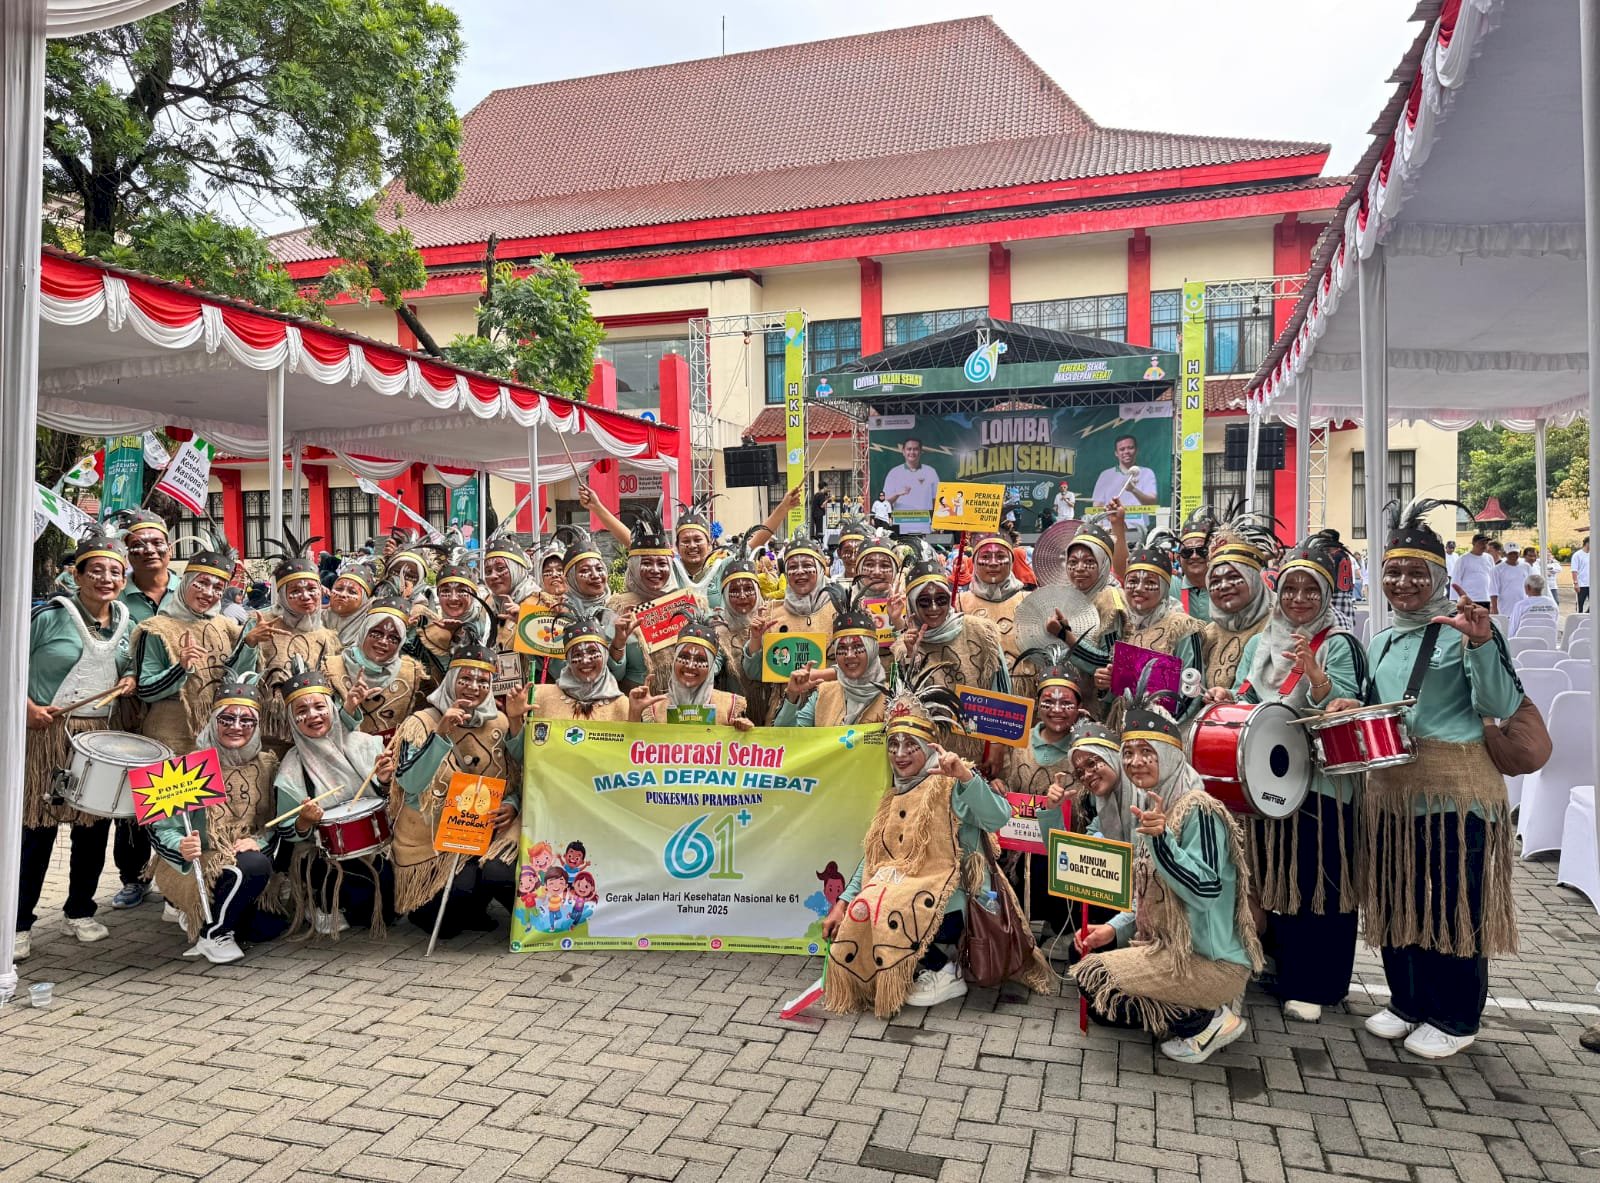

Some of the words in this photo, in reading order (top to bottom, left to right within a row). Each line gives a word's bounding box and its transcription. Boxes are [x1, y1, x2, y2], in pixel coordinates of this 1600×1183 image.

[853, 375, 879, 390] LOMBA
[879, 374, 901, 385] JALAN
[901, 374, 923, 387] SEHAT
[981, 417, 1050, 445] LOMBA
[185, 449, 200, 463] Hari
[956, 446, 1015, 480] JALAN
[1016, 445, 1077, 477] SEHAT
[174, 465, 203, 490] Nasional
[965, 499, 1000, 507] KEHAMILAN
[974, 492, 1001, 500] PERIKSA
[973, 507, 998, 515] SECARA
[979, 514, 998, 522] RUTIN
[795, 642, 809, 650] YUK
[794, 652, 810, 661] IKUT
[966, 695, 983, 703] AYO
[630, 740, 722, 765] Generasi
[728, 742, 785, 768] Sehat
[158, 780, 193, 795] PONED
[594, 770, 656, 791] MASA
[664, 769, 736, 786] DEPAN
[743, 773, 817, 793] HEBAT
[183, 786, 198, 794] Jam
[645, 791, 699, 806] PUSKESMAS
[702, 793, 763, 806] PRAMBANAN
[447, 815, 489, 829] Merokok!
[460, 810, 480, 821] Stop
[1079, 854, 1107, 868] MINUM
[1069, 862, 1090, 875] OBAT
[1091, 867, 1120, 882] CACING
[605, 892, 633, 903] Gerak
[635, 892, 660, 902] Jalan
[662, 891, 681, 902] Hari
[683, 892, 731, 903] Kesehatan
[733, 893, 773, 904] Nasional
[775, 894, 787, 903] ke
[788, 894, 799, 904] 61
[1069, 884, 1091, 897] BULAN
[1091, 890, 1114, 902] SEKALI
[677, 904, 705, 914] Tahun
[707, 904, 729, 915] 2025
